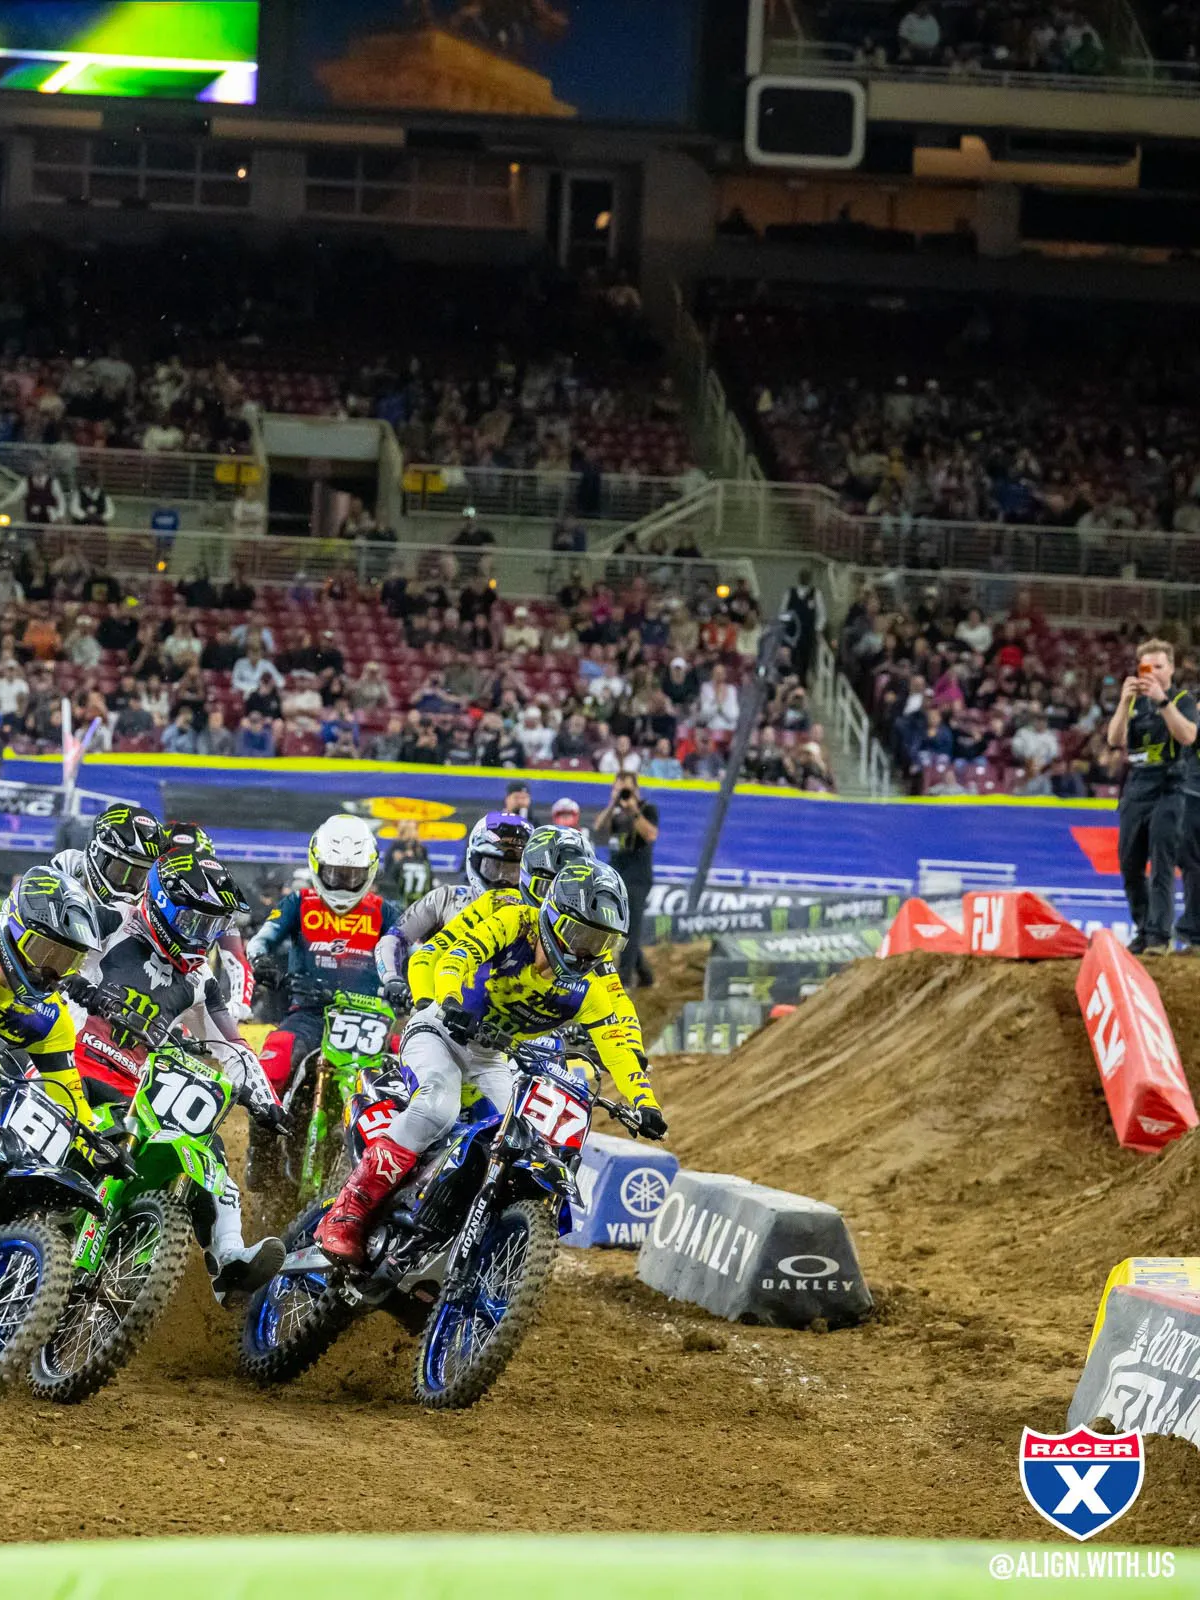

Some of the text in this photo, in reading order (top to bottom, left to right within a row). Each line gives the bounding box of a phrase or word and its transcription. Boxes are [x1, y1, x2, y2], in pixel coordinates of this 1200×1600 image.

[149, 910, 173, 944] MONSTER
[677, 912, 765, 932] MONSTER
[456, 939, 483, 965] THOR
[329, 1014, 387, 1055] 53
[151, 1072, 218, 1134] 10
[522, 1082, 588, 1147] 37
[9, 1099, 71, 1166] 61
[462, 1197, 488, 1259] DUNLOP
[607, 1222, 650, 1244] YAM
[762, 1278, 855, 1292] OAKLEY
